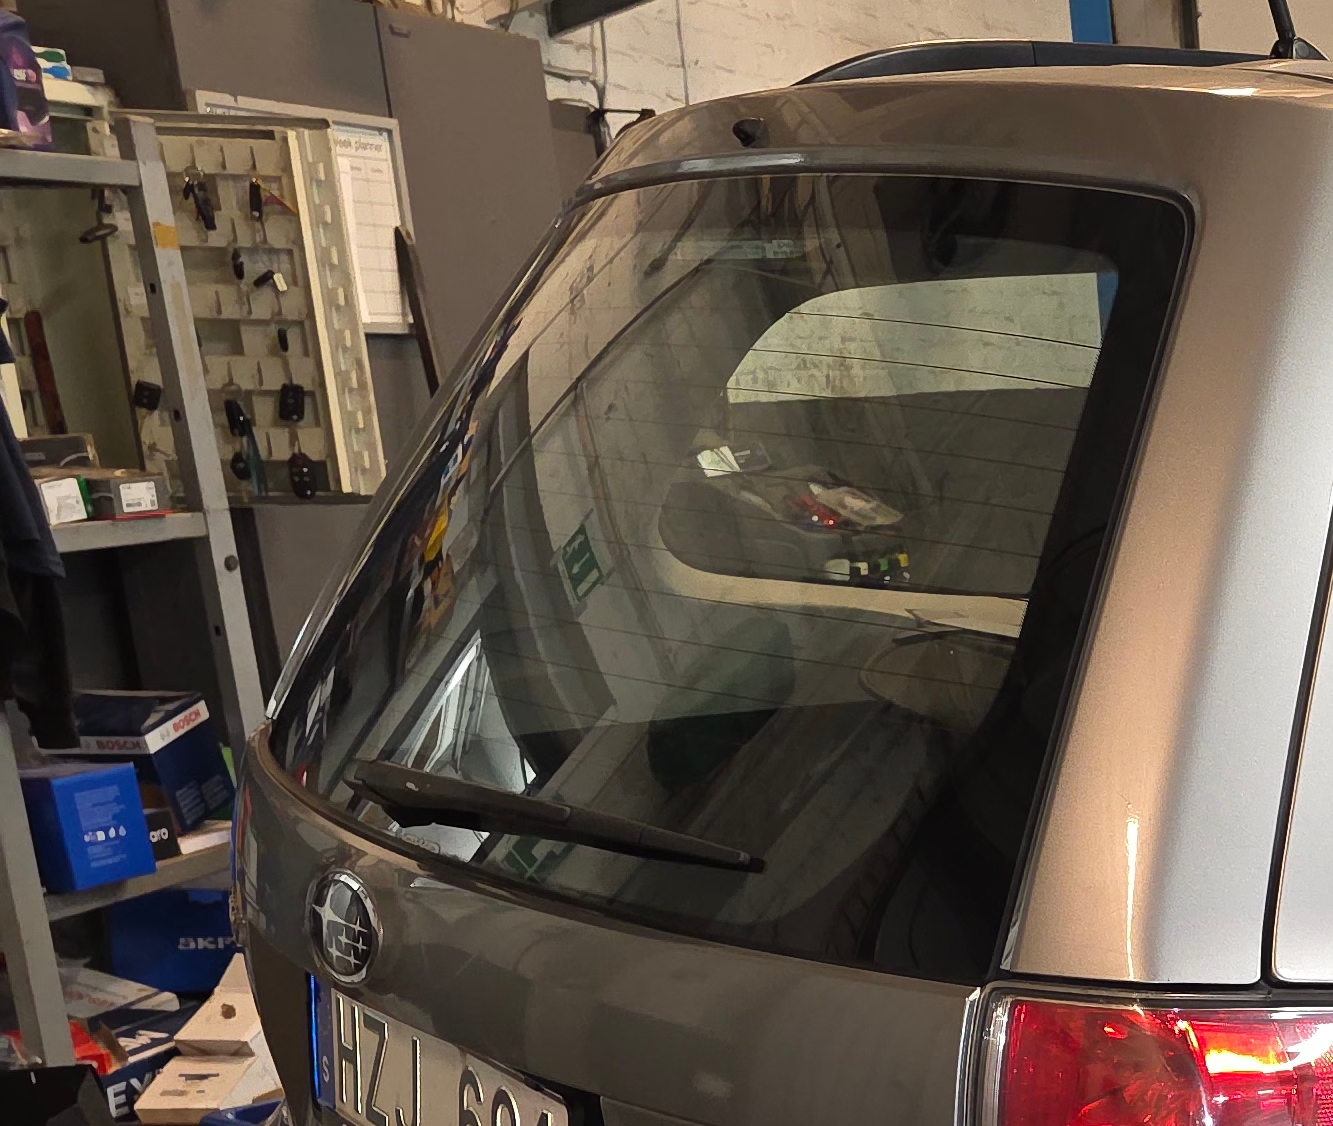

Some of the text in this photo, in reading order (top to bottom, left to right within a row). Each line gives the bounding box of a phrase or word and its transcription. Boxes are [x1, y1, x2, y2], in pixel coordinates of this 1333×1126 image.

[171, 708, 202, 734] BOSCH
[95, 739, 142, 750] BOSCH
[321, 1055, 330, 1083] S
